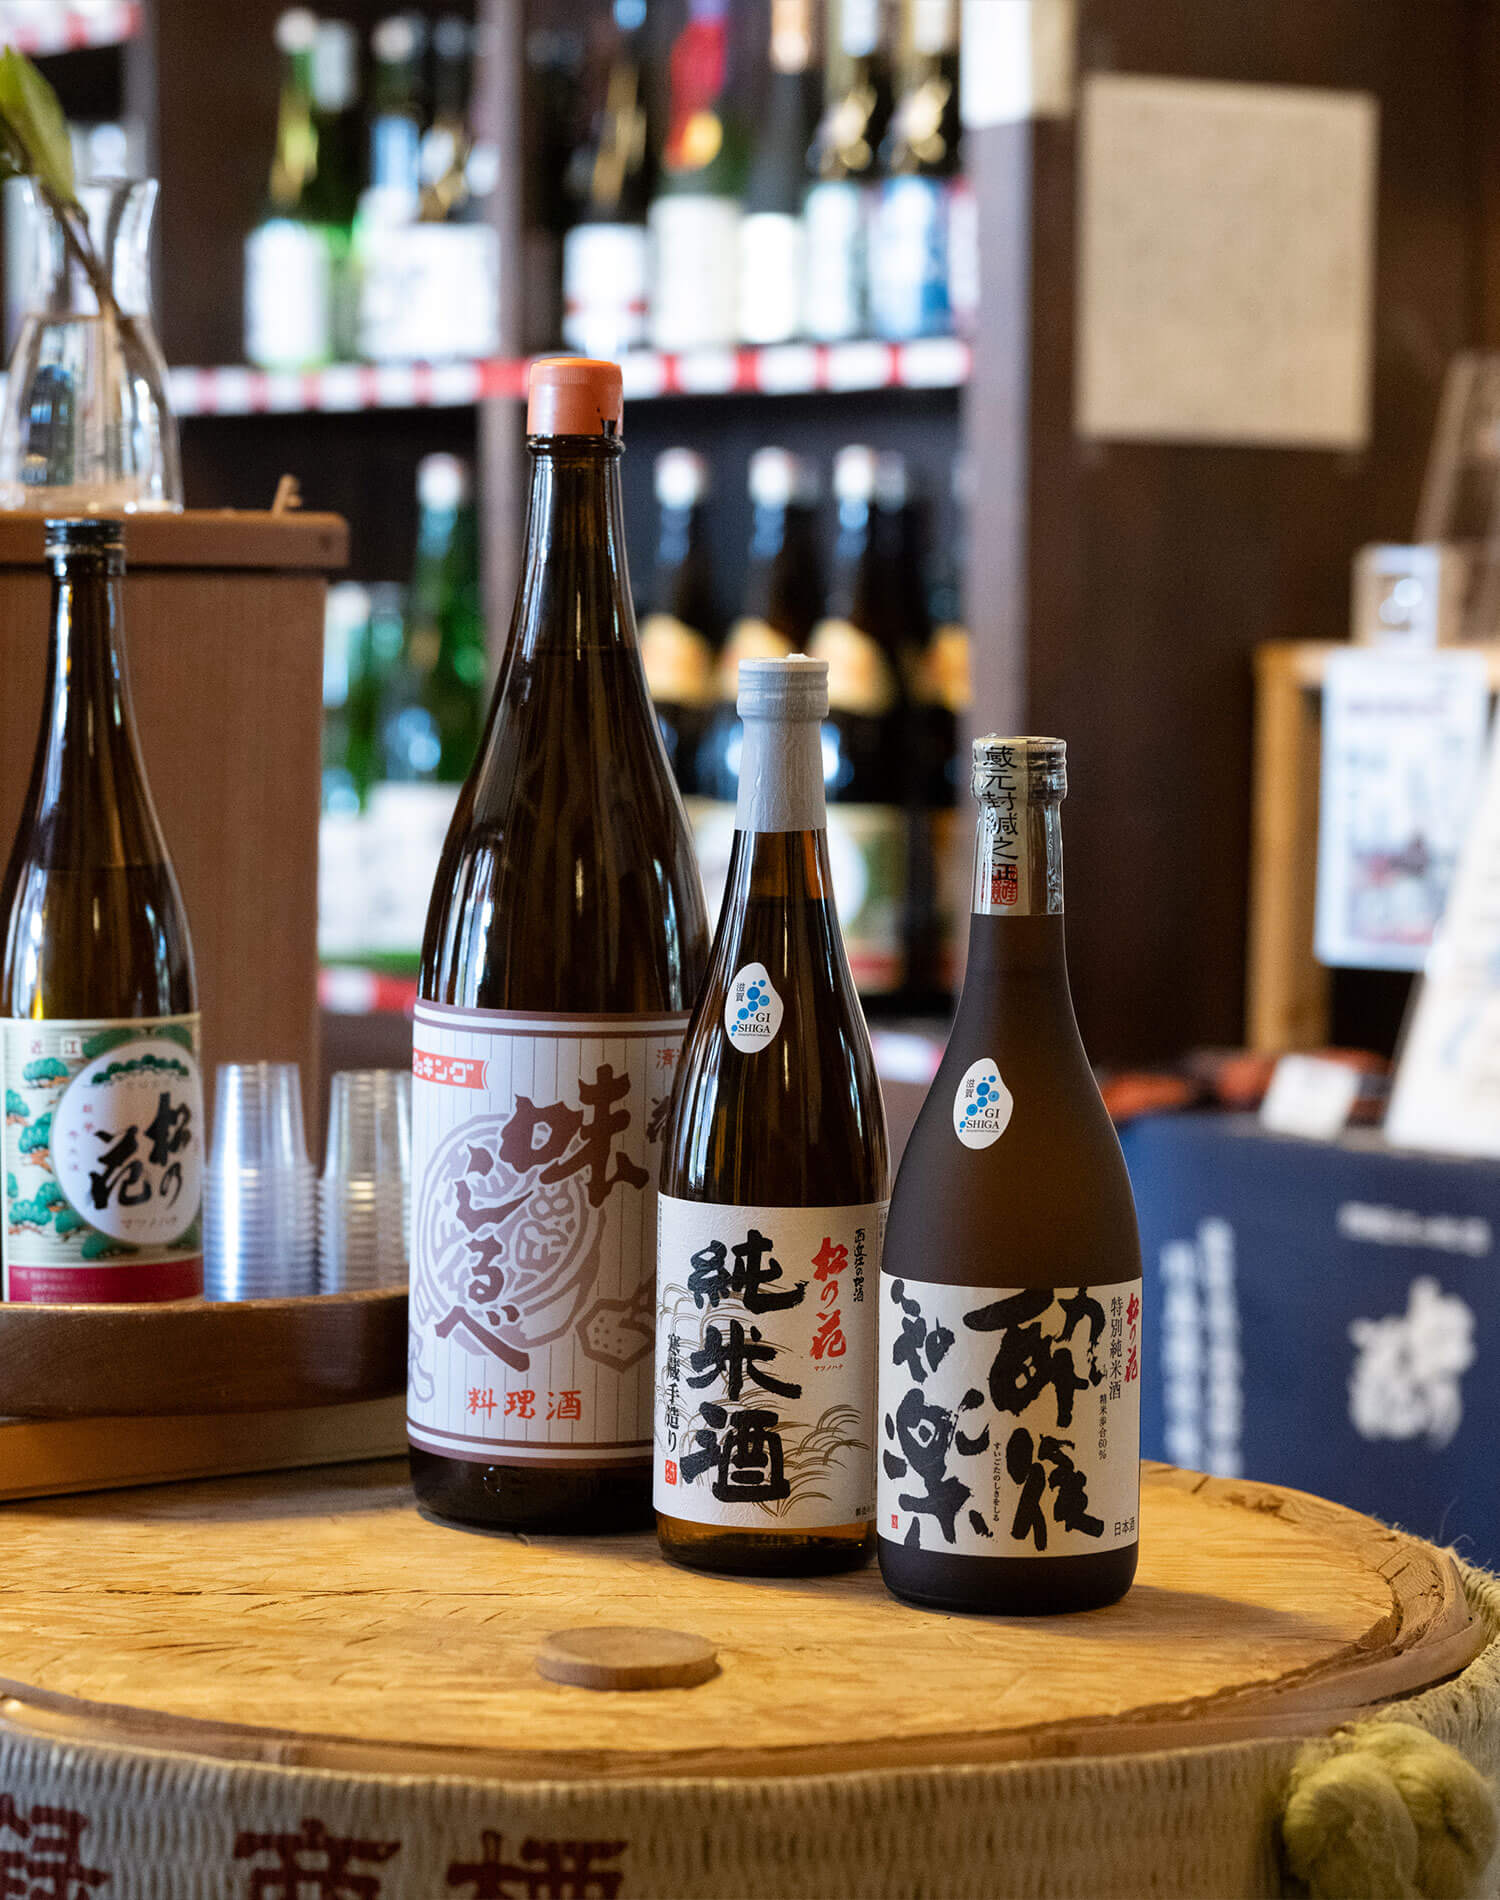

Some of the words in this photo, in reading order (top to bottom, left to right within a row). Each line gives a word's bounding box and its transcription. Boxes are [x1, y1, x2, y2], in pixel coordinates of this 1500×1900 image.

[755, 1012, 771, 1023] GI
[738, 1024, 771, 1034] SHIGA
[656, 1048, 680, 1070] 清
[984, 1107, 1001, 1119] GI
[965, 1120, 1000, 1130] SHIGA
[1108, 1295, 1124, 1401] 特別純米酒
[680, 1229, 810, 1503] 純米酒
[465, 1386, 583, 1421] 料理酒
